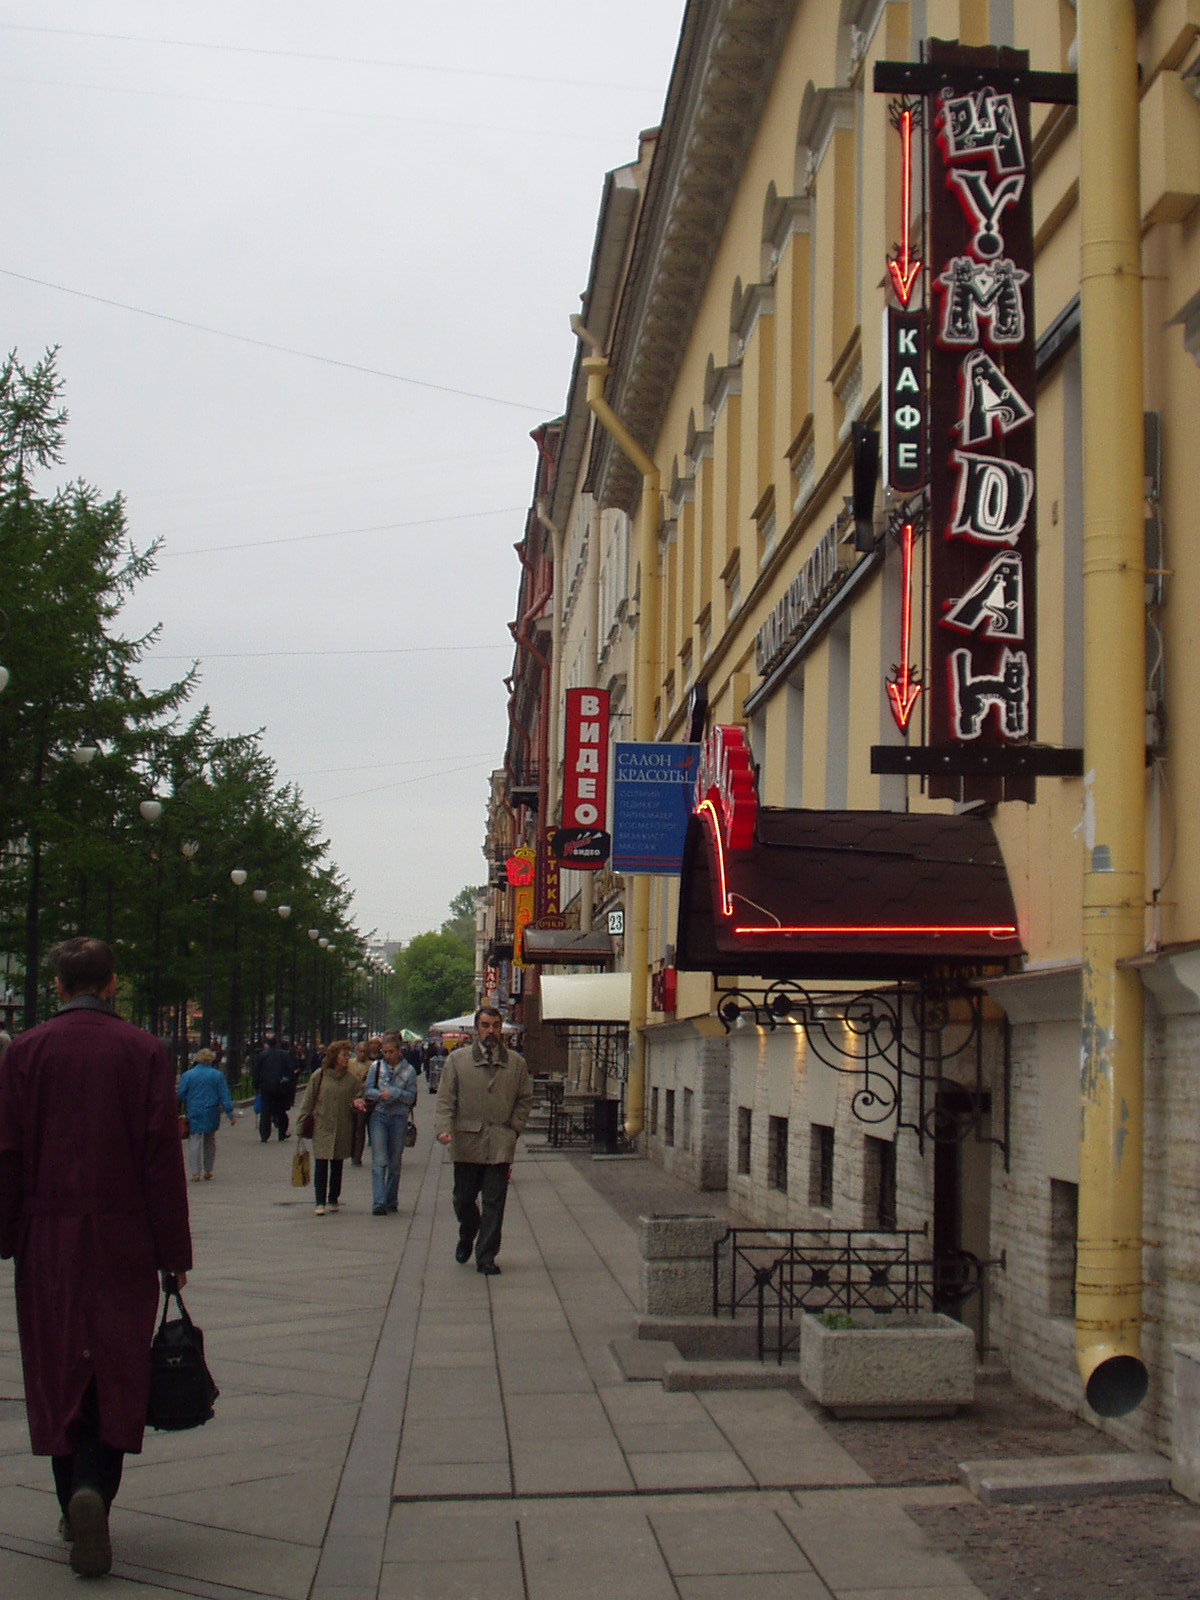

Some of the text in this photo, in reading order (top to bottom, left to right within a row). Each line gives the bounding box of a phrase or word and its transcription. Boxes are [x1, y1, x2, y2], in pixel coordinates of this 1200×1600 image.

[894, 328, 921, 470] КАФЕ
[574, 695, 600, 825] ВИДЕО
[618, 753, 671, 766] САЛОН
[618, 768, 689, 782] КРАСОТЫ
[609, 914, 622, 931] 23
